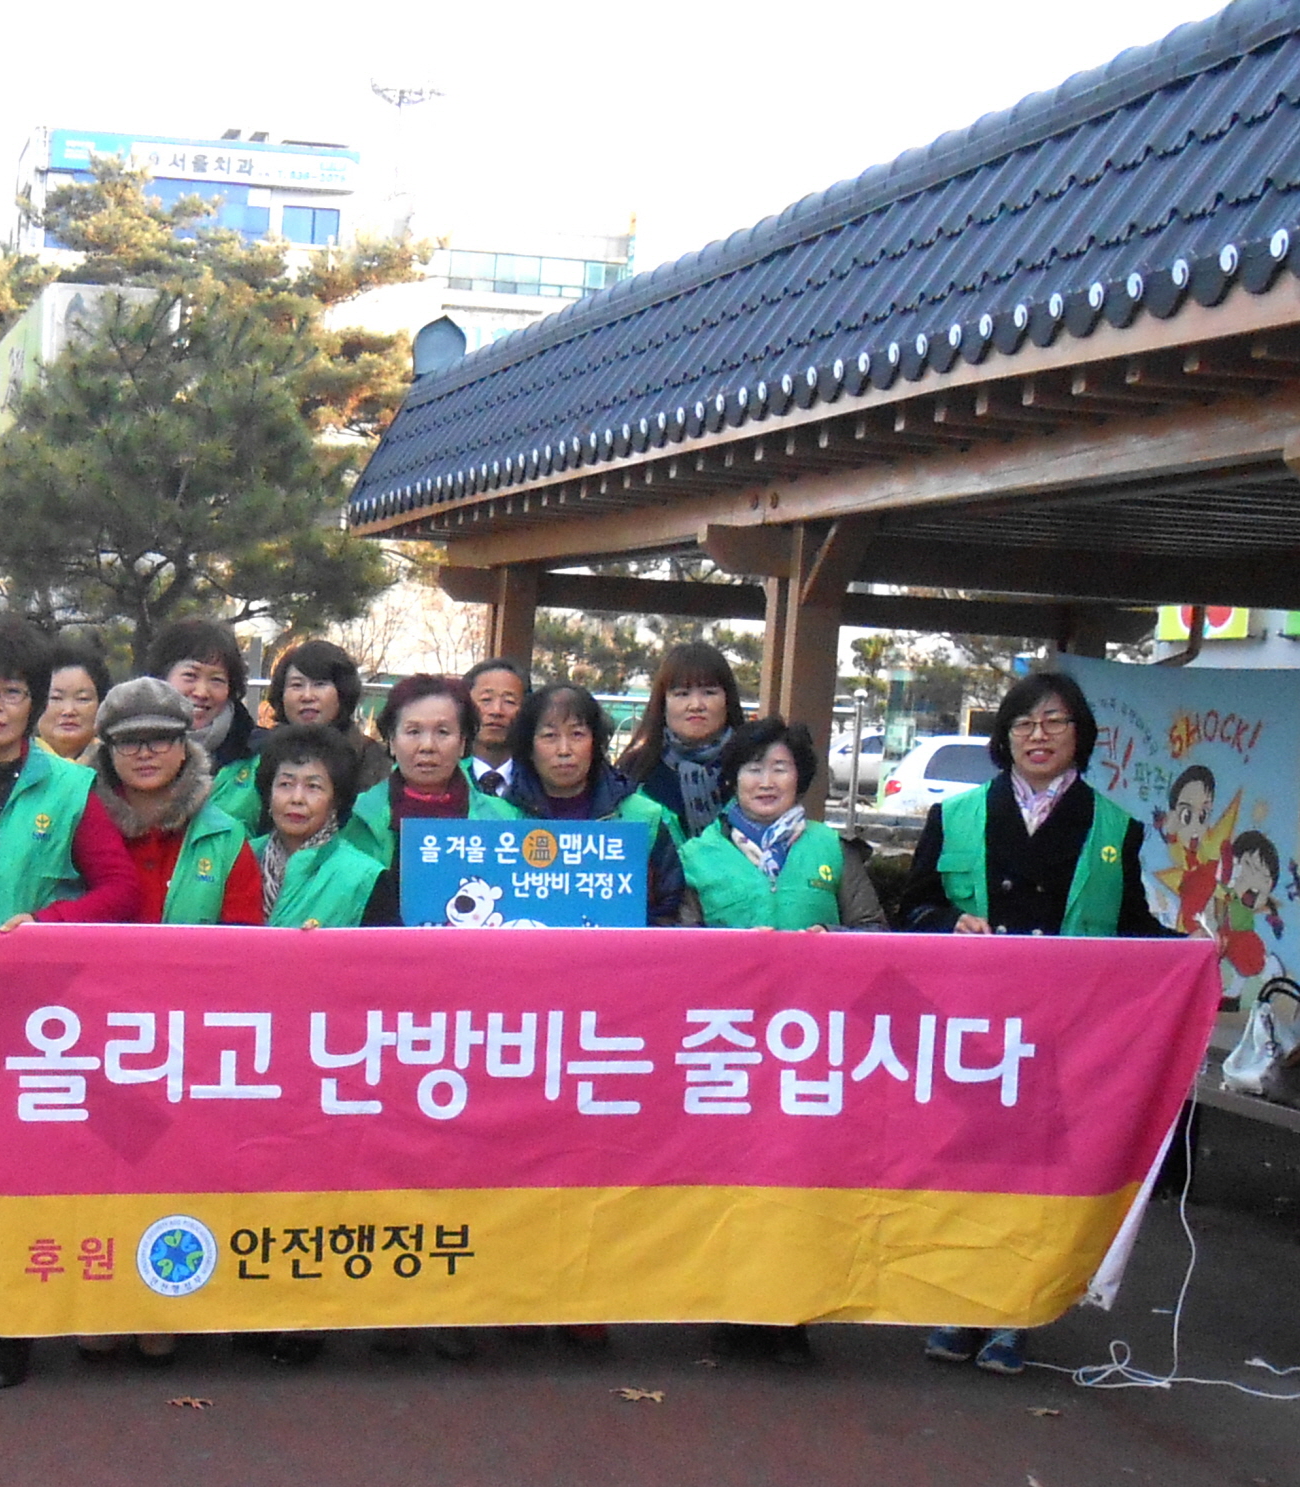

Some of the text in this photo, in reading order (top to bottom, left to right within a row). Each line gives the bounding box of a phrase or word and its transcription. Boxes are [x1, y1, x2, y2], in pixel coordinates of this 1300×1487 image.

[168, 153, 255, 177] 서울치과
[1168, 709, 1262, 764] SHOCK!
[419, 835, 442, 863] 올
[446, 836, 487, 863] 겨울
[494, 832, 520, 864] 온
[559, 833, 626, 865] 맵시로
[511, 872, 633, 900] 난방비 걱정 X
[5, 1005, 282, 1122] 올리고
[310, 1010, 655, 1120] 난방비는
[675, 1008, 1036, 1117] 줄입시다
[24, 1236, 115, 1283] 후원
[229, 1223, 476, 1280] 안전행정부
